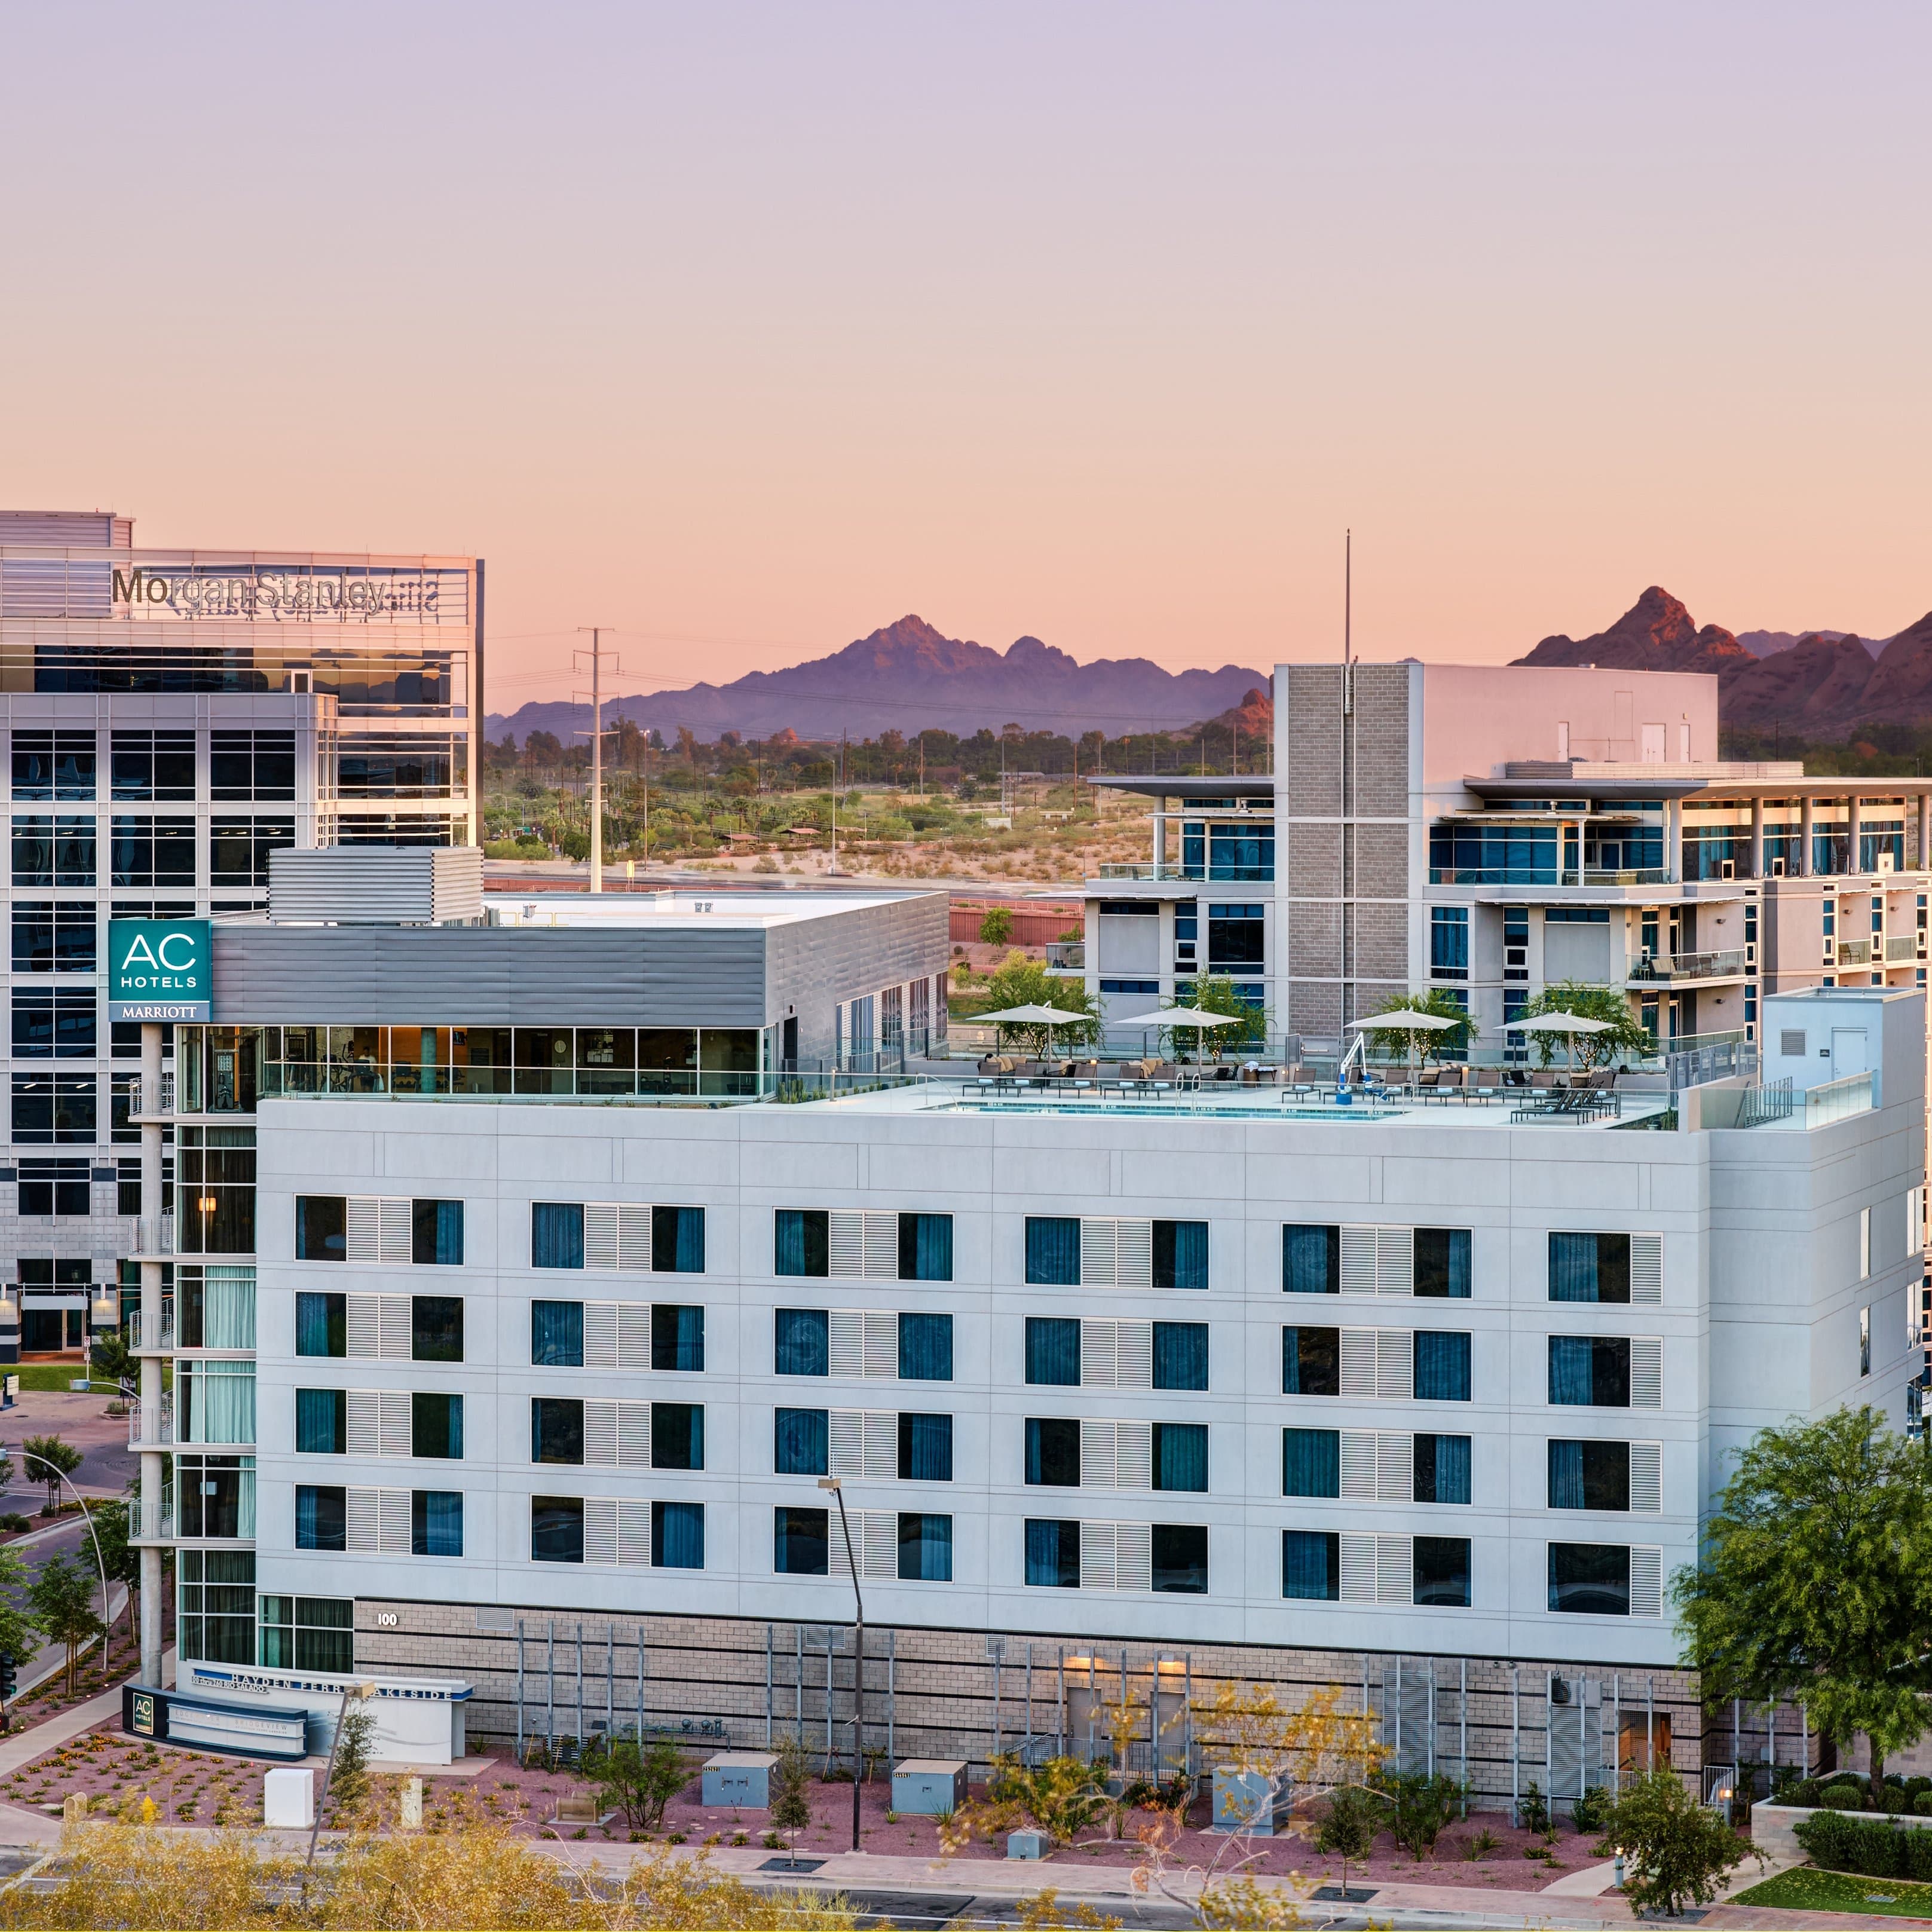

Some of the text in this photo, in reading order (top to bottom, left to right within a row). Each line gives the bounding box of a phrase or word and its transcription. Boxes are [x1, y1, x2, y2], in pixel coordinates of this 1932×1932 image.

[112, 570, 247, 613] Morgan
[256, 571, 387, 616] Stanley
[121, 933, 196, 970] AC
[121, 977, 197, 988] HOTELS
[122, 1006, 197, 1018] MARRIOTT
[378, 1613, 397, 1625] 100
[232, 1674, 452, 1700] HAYDEN FERR AKESIDE
[237, 1683, 264, 1692] SALADO
[136, 1700, 151, 1715] AC
[235, 1719, 287, 1730] BRIDGEVIEW
